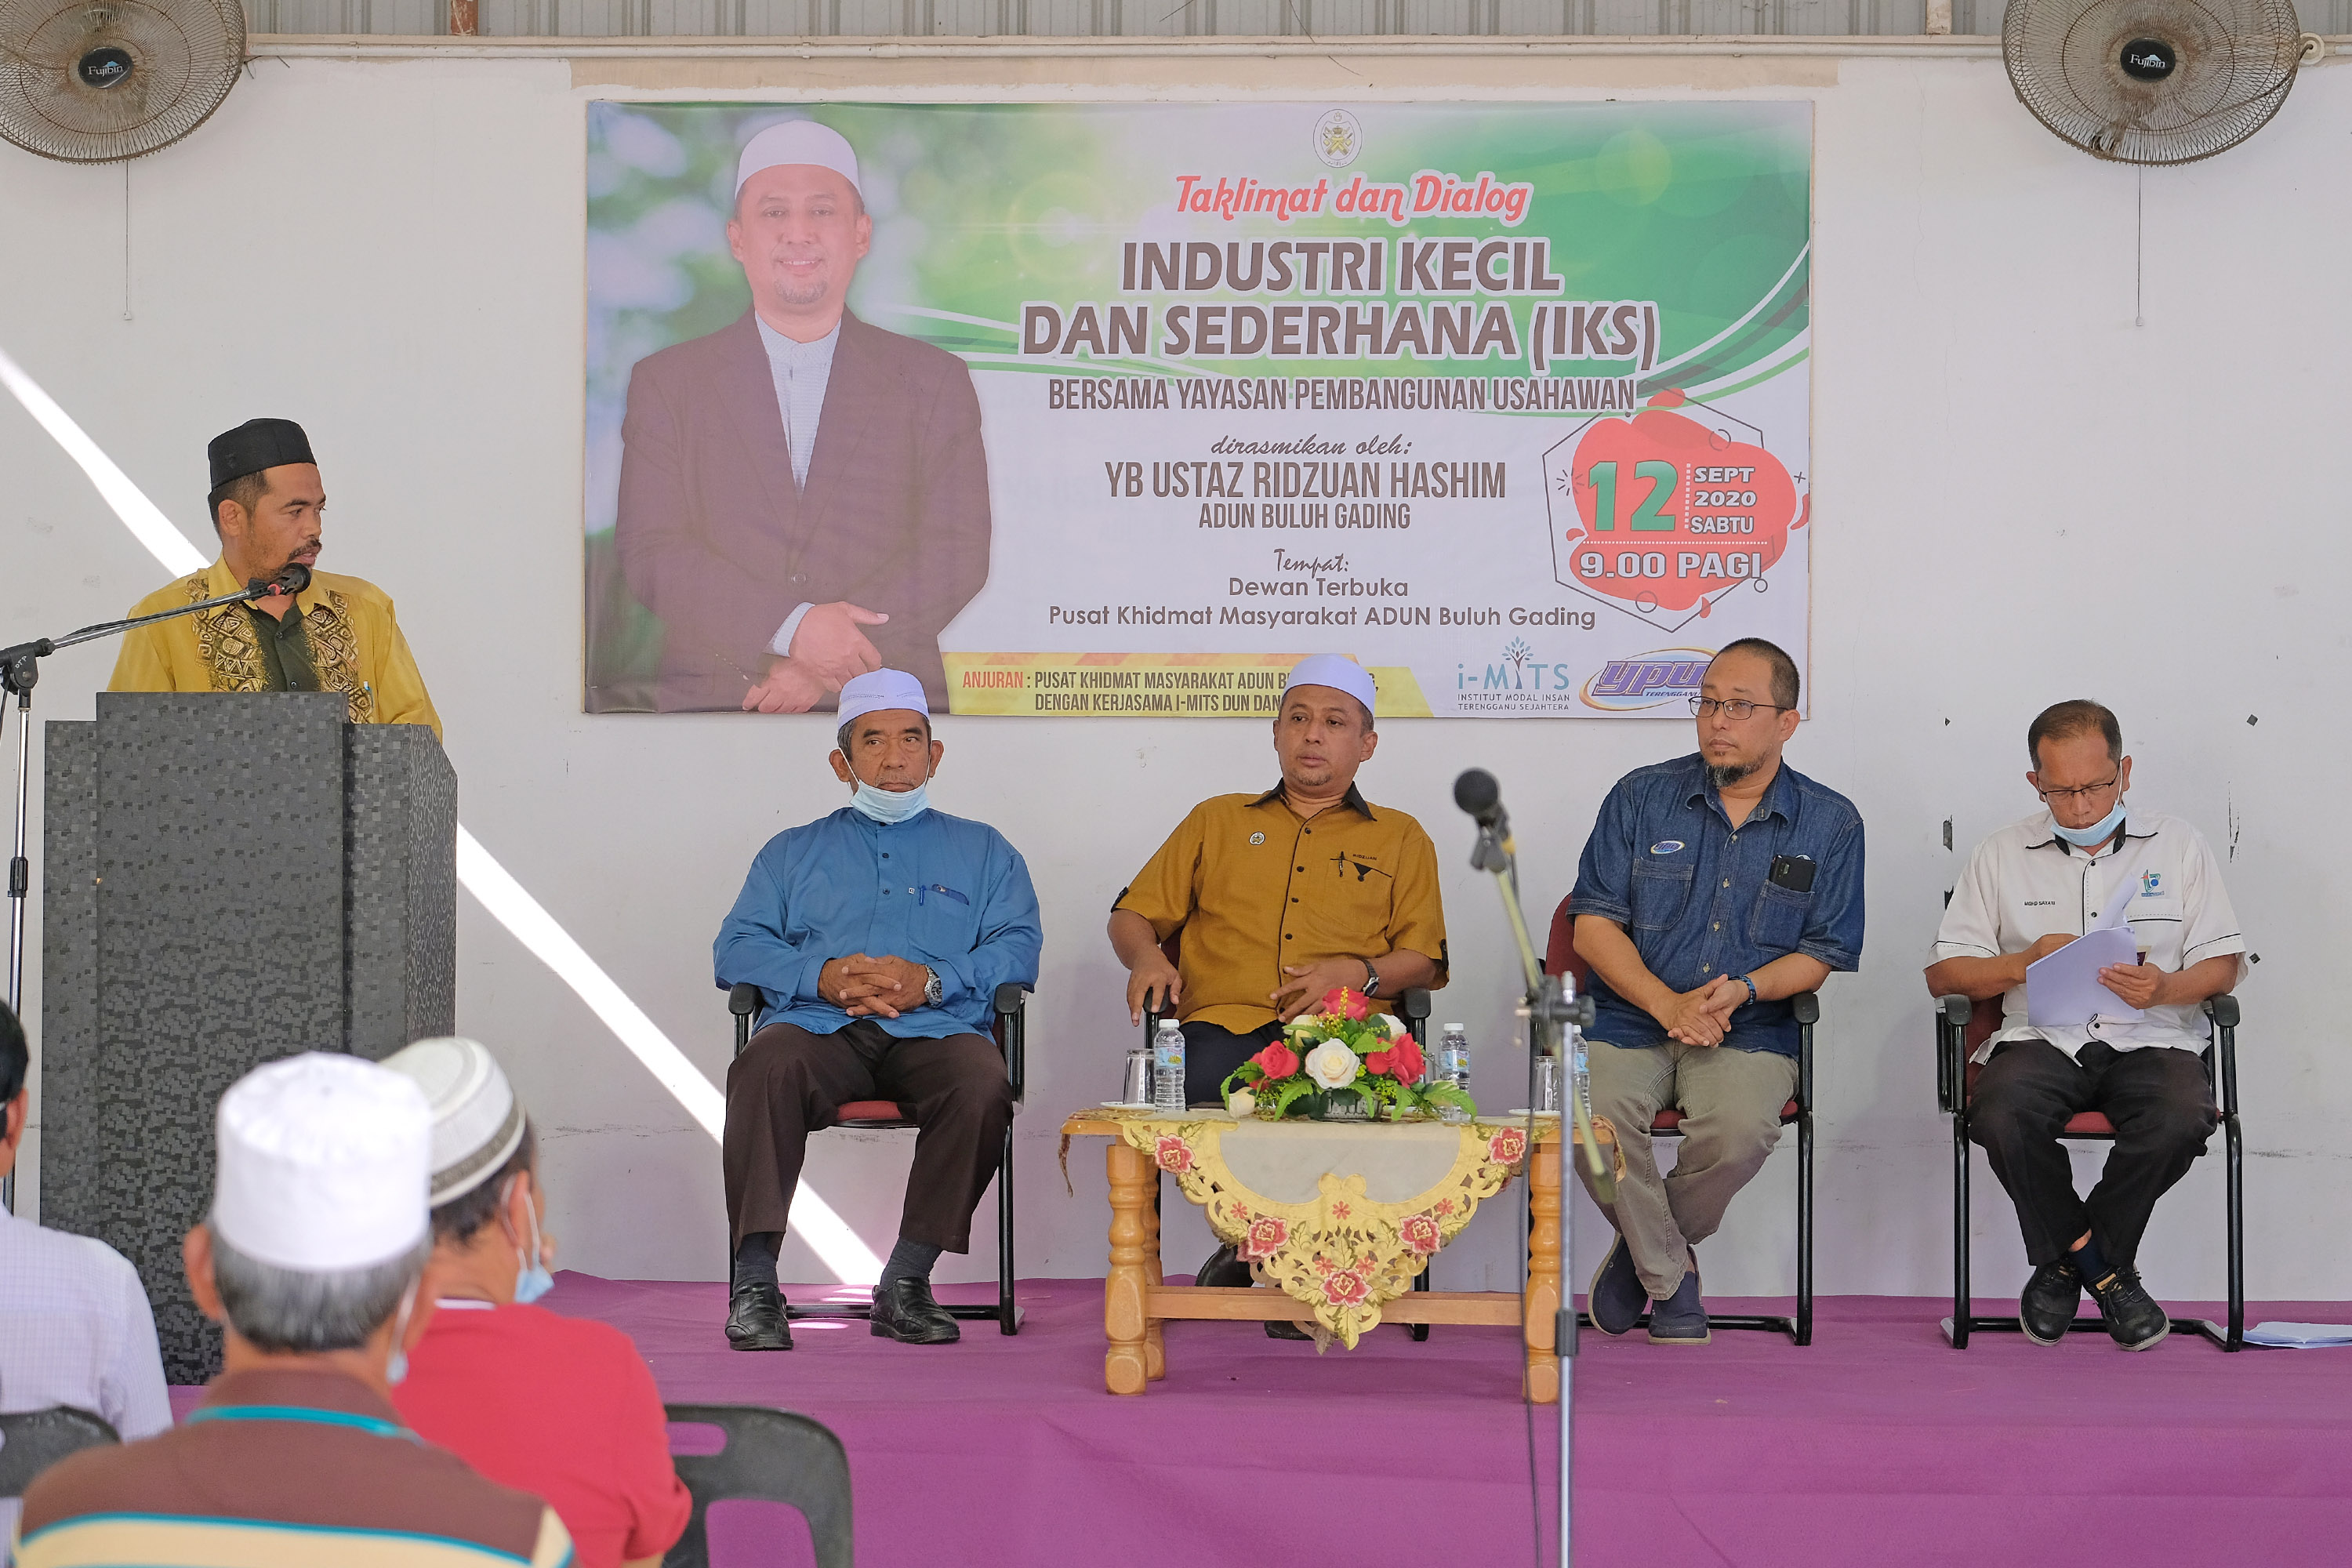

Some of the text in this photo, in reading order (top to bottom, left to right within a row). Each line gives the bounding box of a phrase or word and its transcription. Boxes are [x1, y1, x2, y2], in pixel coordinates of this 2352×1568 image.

[1177, 175, 1529, 222] Taklimat dan Dialog
[1123, 241, 1559, 290] INDUSTRI KECIL
[1023, 307, 1657, 371] DAN SEDERHANA (IKS)
[1049, 379, 1635, 410] BERSAMA YAYASAN PEMBANGUNAN USAHAWAN
[1211, 434, 1412, 456] dirasmikan oleh:
[1105, 462, 1505, 497] YB USTAZ RIDZUAN HASHIM
[1694, 467, 1755, 483] SEPT
[1588, 459, 1679, 532] 12
[1694, 491, 1757, 506] 2020
[1200, 503, 1410, 528] ADUN BULUH GADING
[1690, 517, 1754, 534] SABTU
[1273, 548, 1349, 578] Tempat:
[1580, 552, 1762, 579] 9.00 PAGI
[1229, 578, 1409, 597] Dewan Terbuka
[1050, 605, 1596, 630] Pusat Khidmat Masyarakat ADUN Buluh Gading
[963, 671, 1023, 688] ANJURAN
[1035, 672, 1076, 688] PUSAT
[1080, 672, 1141, 688] KHIDMAT
[1145, 672, 1233, 688] MASYARAKAT
[1237, 672, 1274, 689] ADUN
[1035, 694, 1282, 711] DENGAN KERJASAMA I-MITS DUN DAN
